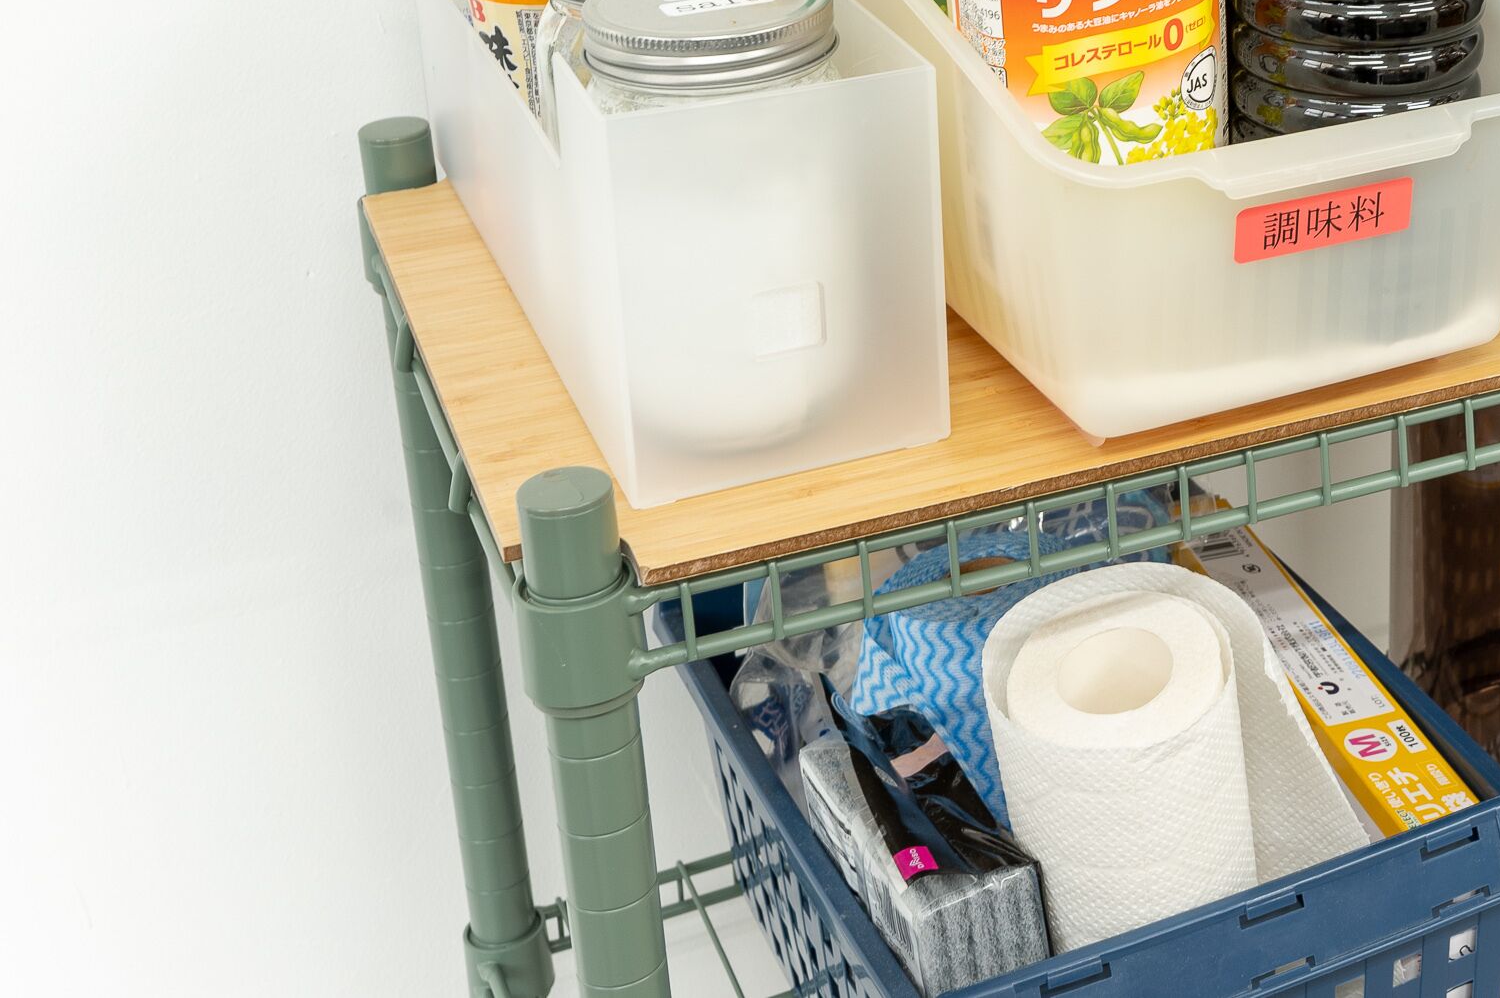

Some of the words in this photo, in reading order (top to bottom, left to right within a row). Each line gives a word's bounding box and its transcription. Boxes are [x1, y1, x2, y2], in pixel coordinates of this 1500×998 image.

[1187, 73, 1207, 93] JAS
[1263, 191, 1385, 250] 調味料
[1348, 734, 1388, 758] M
